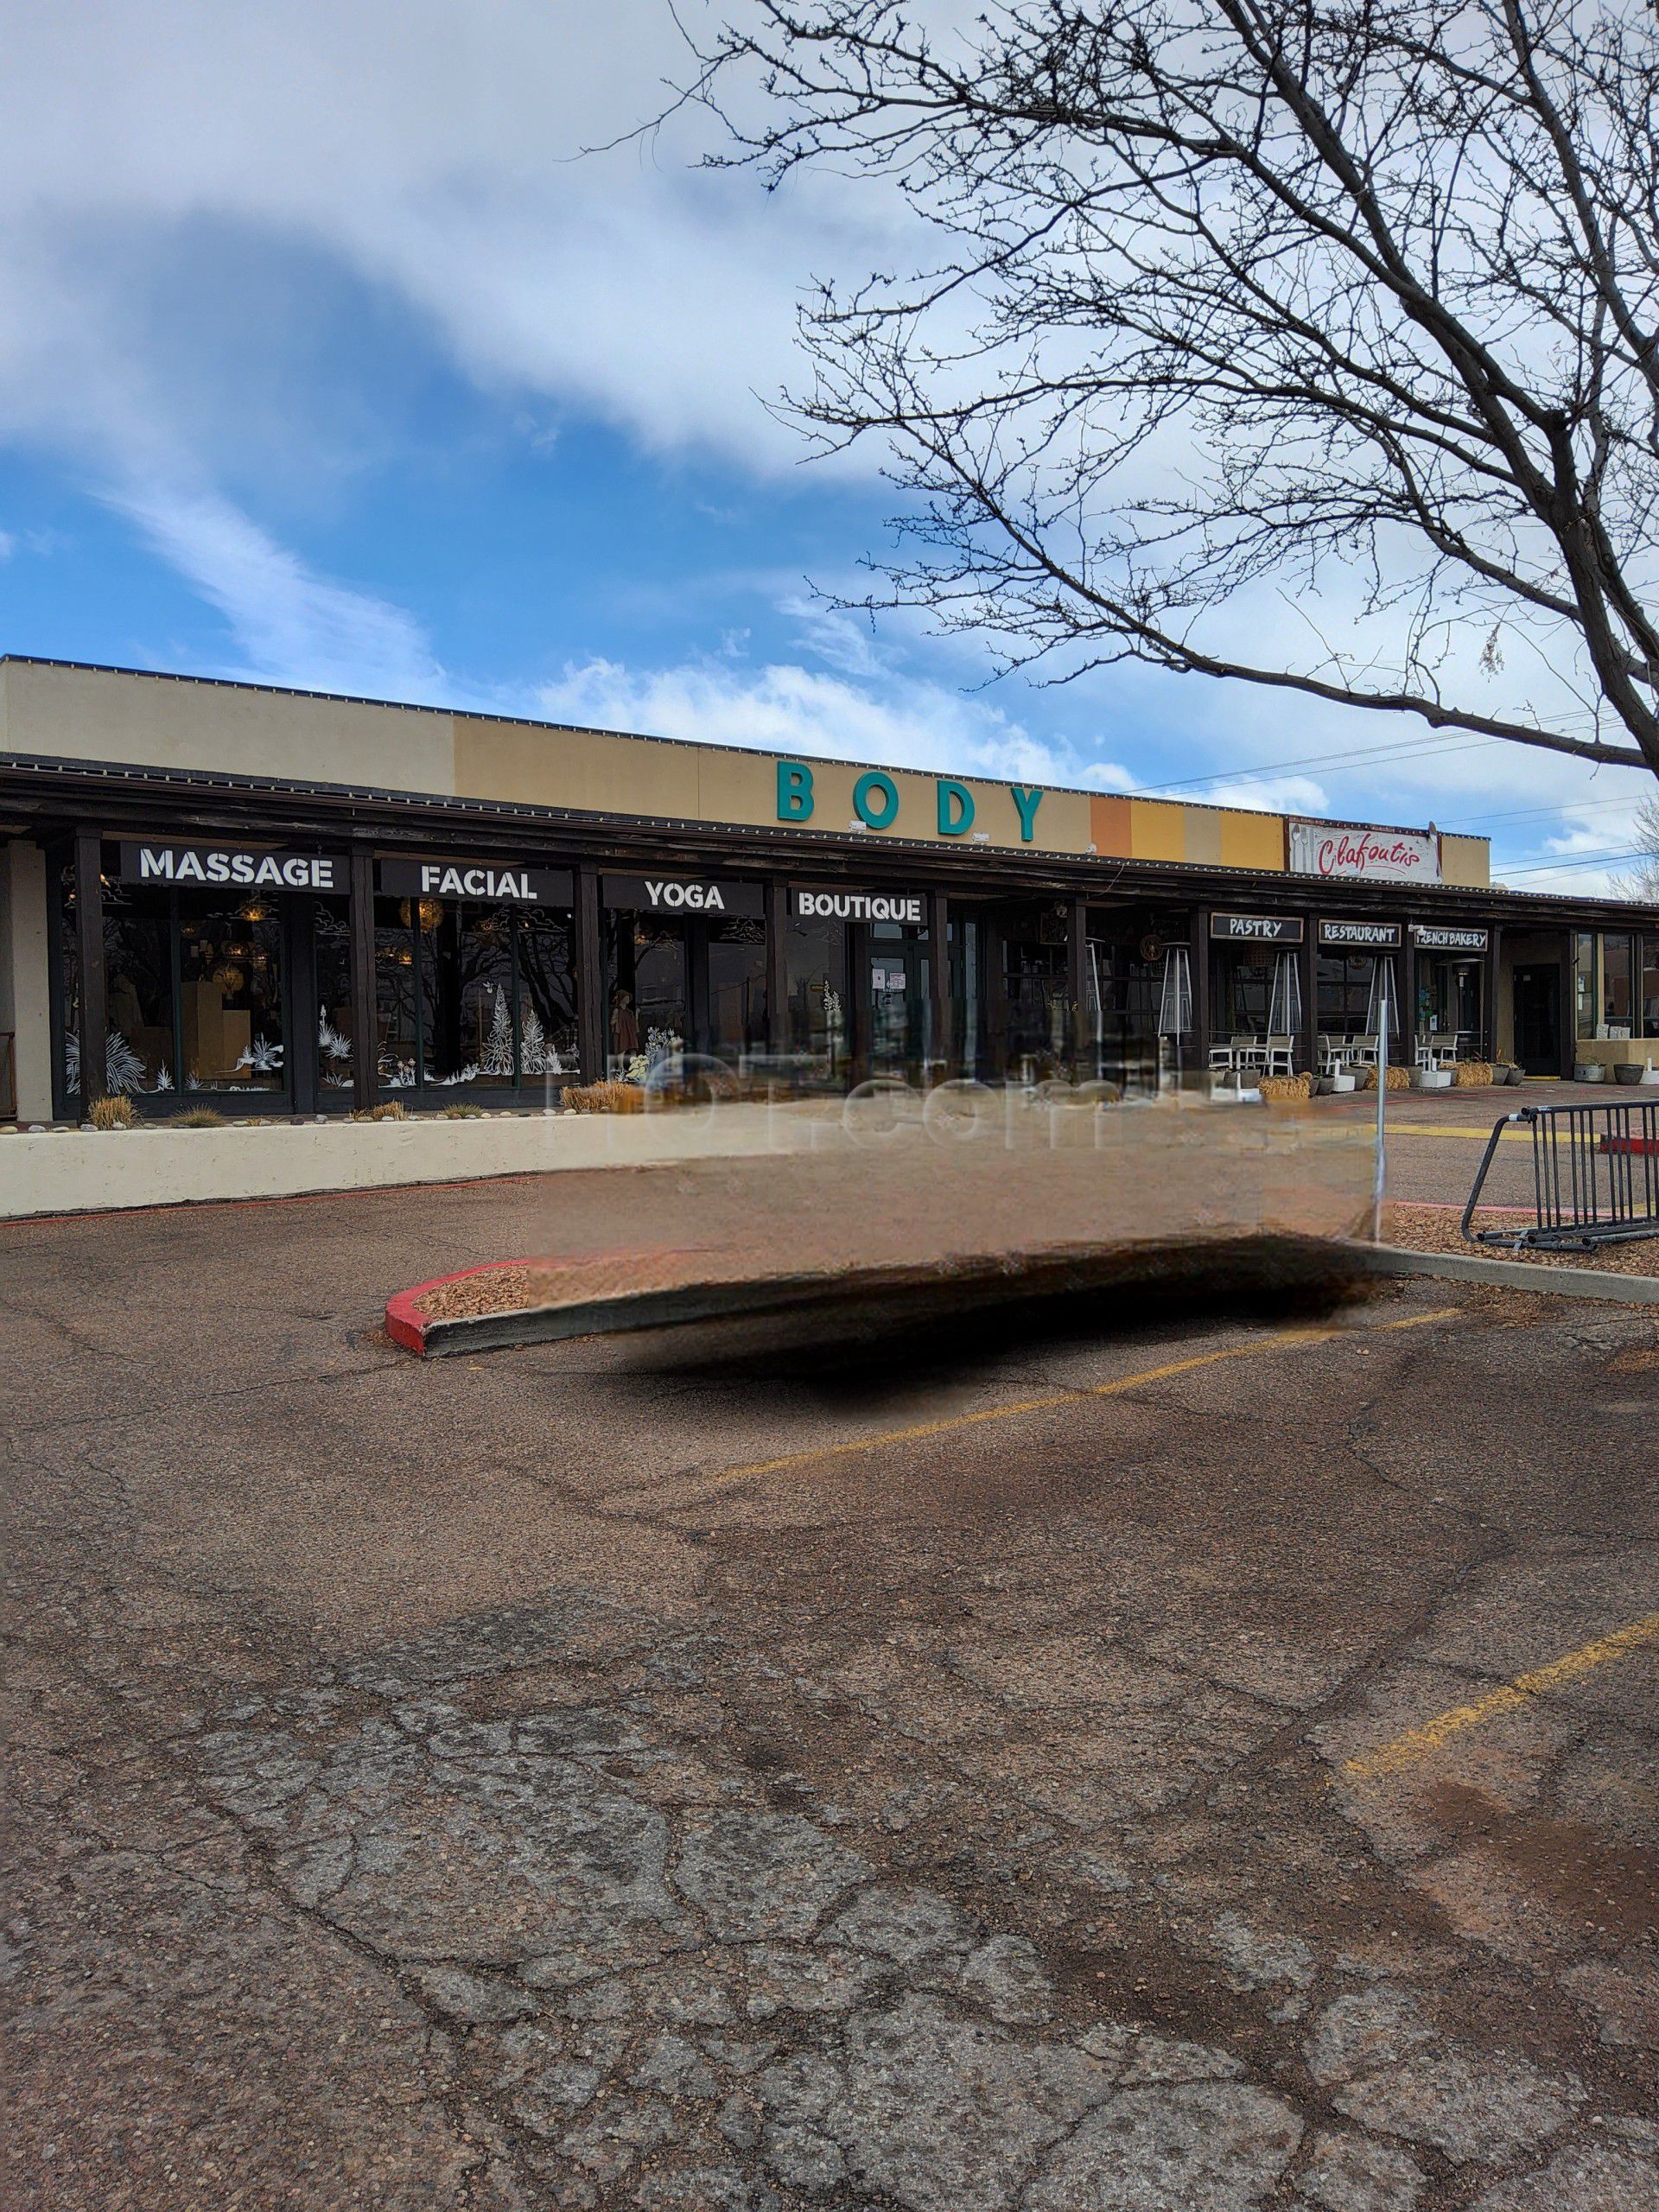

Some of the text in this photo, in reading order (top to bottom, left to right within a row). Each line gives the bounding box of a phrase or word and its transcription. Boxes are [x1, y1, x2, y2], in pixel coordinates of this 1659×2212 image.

[777, 760, 1044, 842] BODY
[140, 849, 334, 889] MASSAGE
[1319, 833, 1420, 875] Clafoutis
[422, 866, 538, 899] FACIAL
[645, 880, 725, 910] YOGA
[798, 892, 921, 922] BOUTIQUE
[1230, 918, 1282, 938] PASTRY
[1324, 924, 1395, 943] RESTAURANT
[1449, 931, 1486, 947] BAKERY
